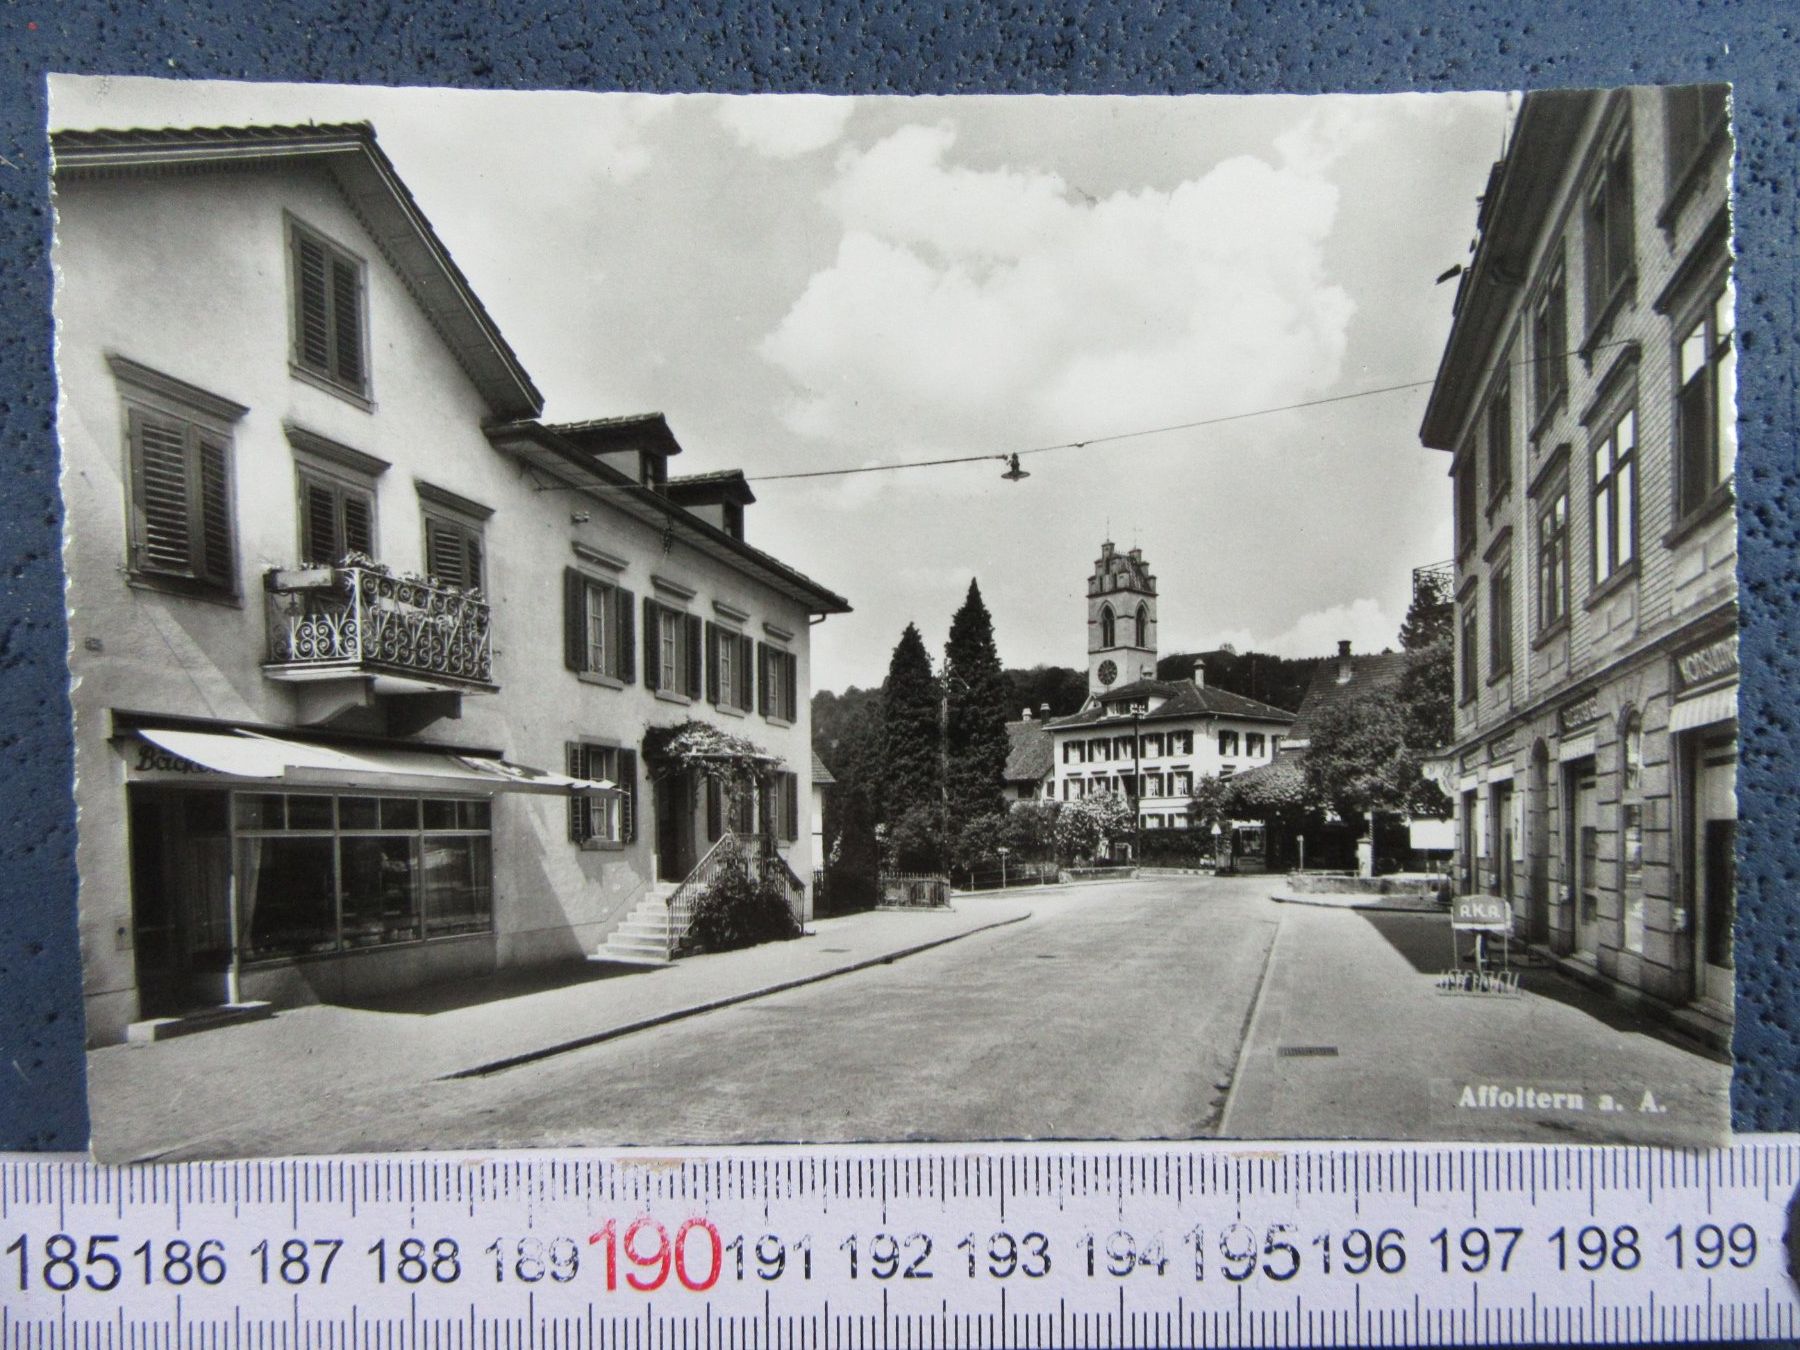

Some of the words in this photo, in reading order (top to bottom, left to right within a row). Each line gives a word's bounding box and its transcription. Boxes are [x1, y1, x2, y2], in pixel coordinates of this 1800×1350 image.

[1458, 1084, 1584, 1110] Affoltern
[1598, 1093, 1625, 1111] a.
[1638, 1089, 1668, 1113] A.
[6, 1233, 122, 1291] 185
[133, 1239, 227, 1285] 186
[250, 1238, 344, 1284] 187
[367, 1237, 461, 1284] 188
[484, 1236, 579, 1283] 189
[588, 1217, 722, 1291] 190
[725, 1233, 812, 1281] 191
[839, 1232, 934, 1279] 192
[957, 1230, 1052, 1278] 193
[1076, 1229, 1169, 1277] 194
[1183, 1223, 1301, 1282] 195
[1312, 1229, 1407, 1274] 196
[1429, 1227, 1524, 1272] 197
[1547, 1224, 1642, 1271] 198
[1664, 1222, 1758, 1270] 199
